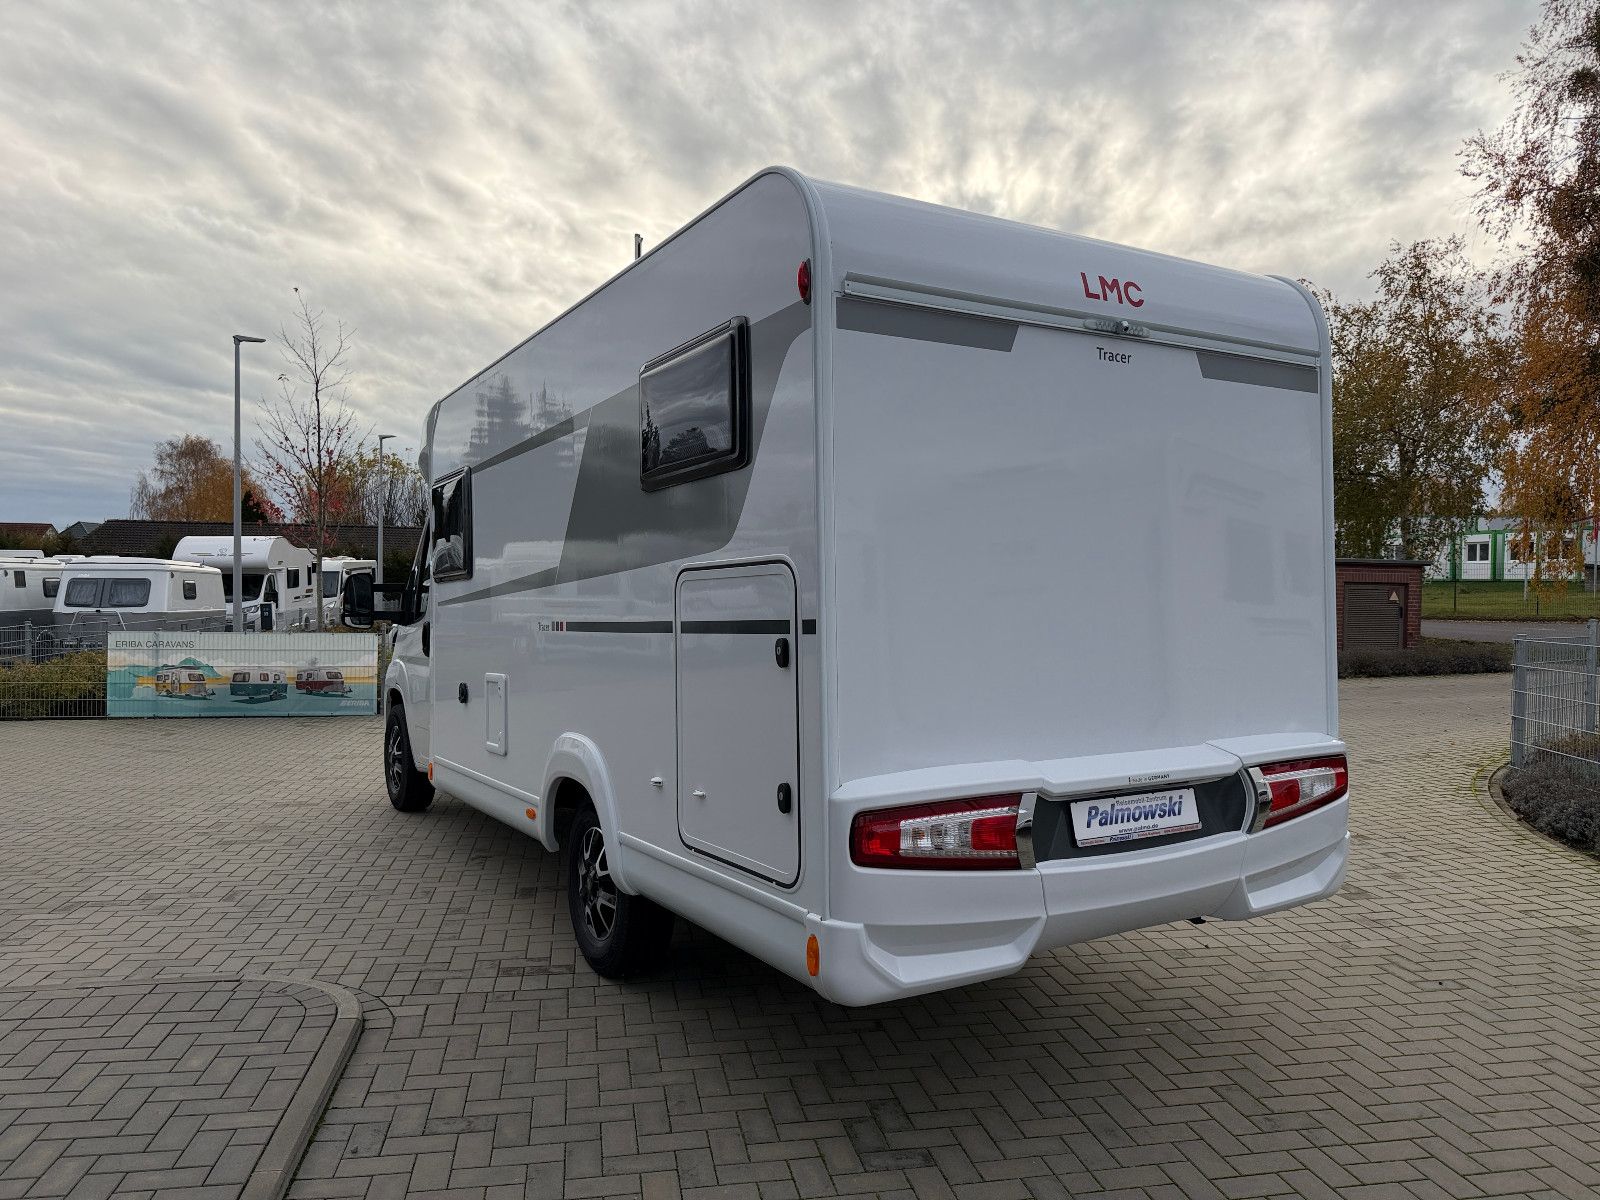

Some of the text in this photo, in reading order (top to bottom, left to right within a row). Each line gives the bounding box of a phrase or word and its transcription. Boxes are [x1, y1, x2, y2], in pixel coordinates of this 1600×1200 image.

[1080, 272, 1145, 308] LMC
[1096, 346, 1132, 364] Tracer
[115, 640, 195, 649] ERIBA CARAVANS
[1086, 794, 1184, 828] Palmowski
